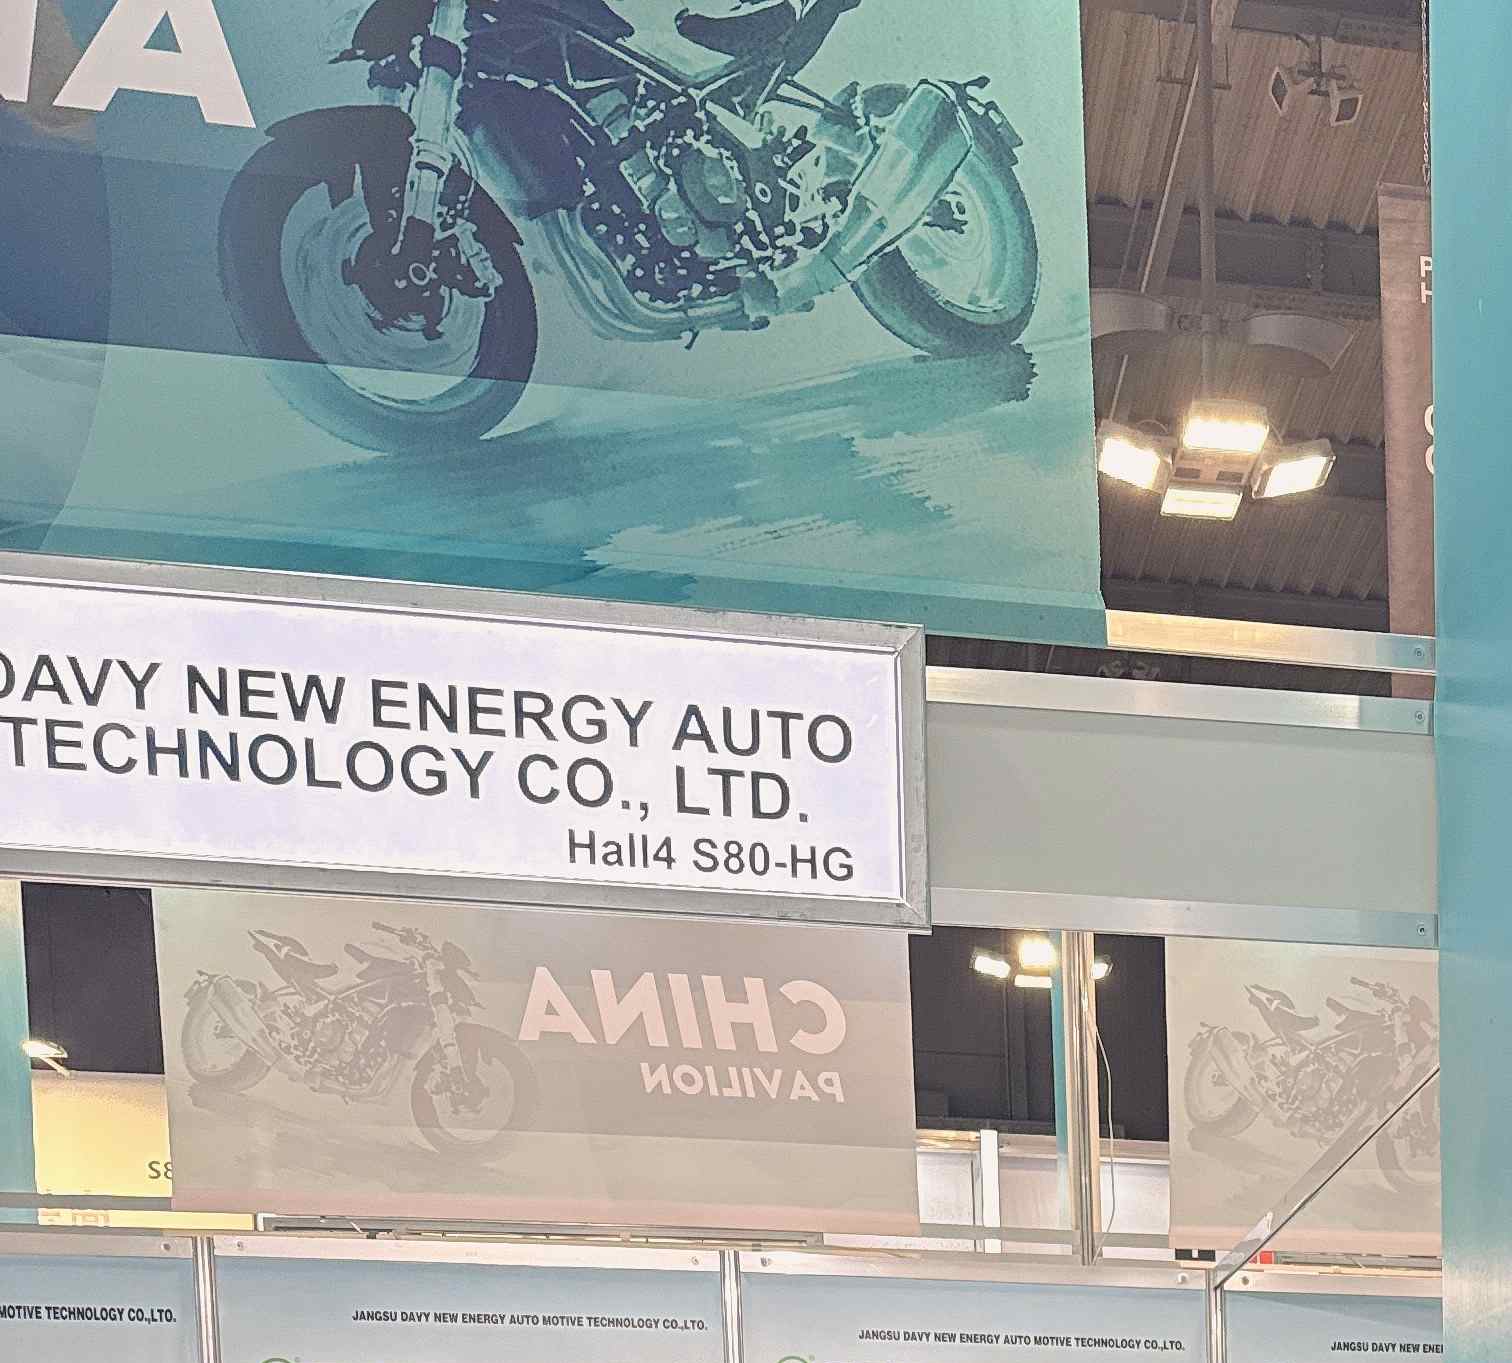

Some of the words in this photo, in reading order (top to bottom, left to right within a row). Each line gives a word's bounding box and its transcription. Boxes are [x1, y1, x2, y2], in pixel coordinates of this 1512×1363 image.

[187, 664, 346, 727] NEW
[371, 678, 654, 750] ENERGY
[671, 701, 854, 765] AUTO
[0, 716, 493, 801] TECHNOLOGY
[517, 756, 651, 822] CO.,
[676, 765, 810, 824] LTD.
[567, 828, 676, 872] Hall4
[693, 837, 855, 883] S80-HG
[44, 1306, 125, 1321] TECHNOLOGY
[400, 1311, 430, 1322] DAVY
[434, 1312, 458, 1323] NEW
[462, 1313, 505, 1324] ENERGY
[509, 1314, 539, 1326] AUTO
[542, 1315, 583, 1326] MOTIVE
[587, 1316, 660, 1328] TECHNOLOGY
[903, 1331, 931, 1342] DAVY
[934, 1332, 957, 1343] NEW
[959, 1333, 1000, 1344] ENERGY
[1003, 1334, 1031, 1345] AUTO
[1034, 1336, 1071, 1347] MOTIVE
[1074, 1337, 1141, 1349] TECHNOLOGY
[1371, 1342, 1397, 1352] DAVY
[1400, 1343, 1420, 1353] NEW
